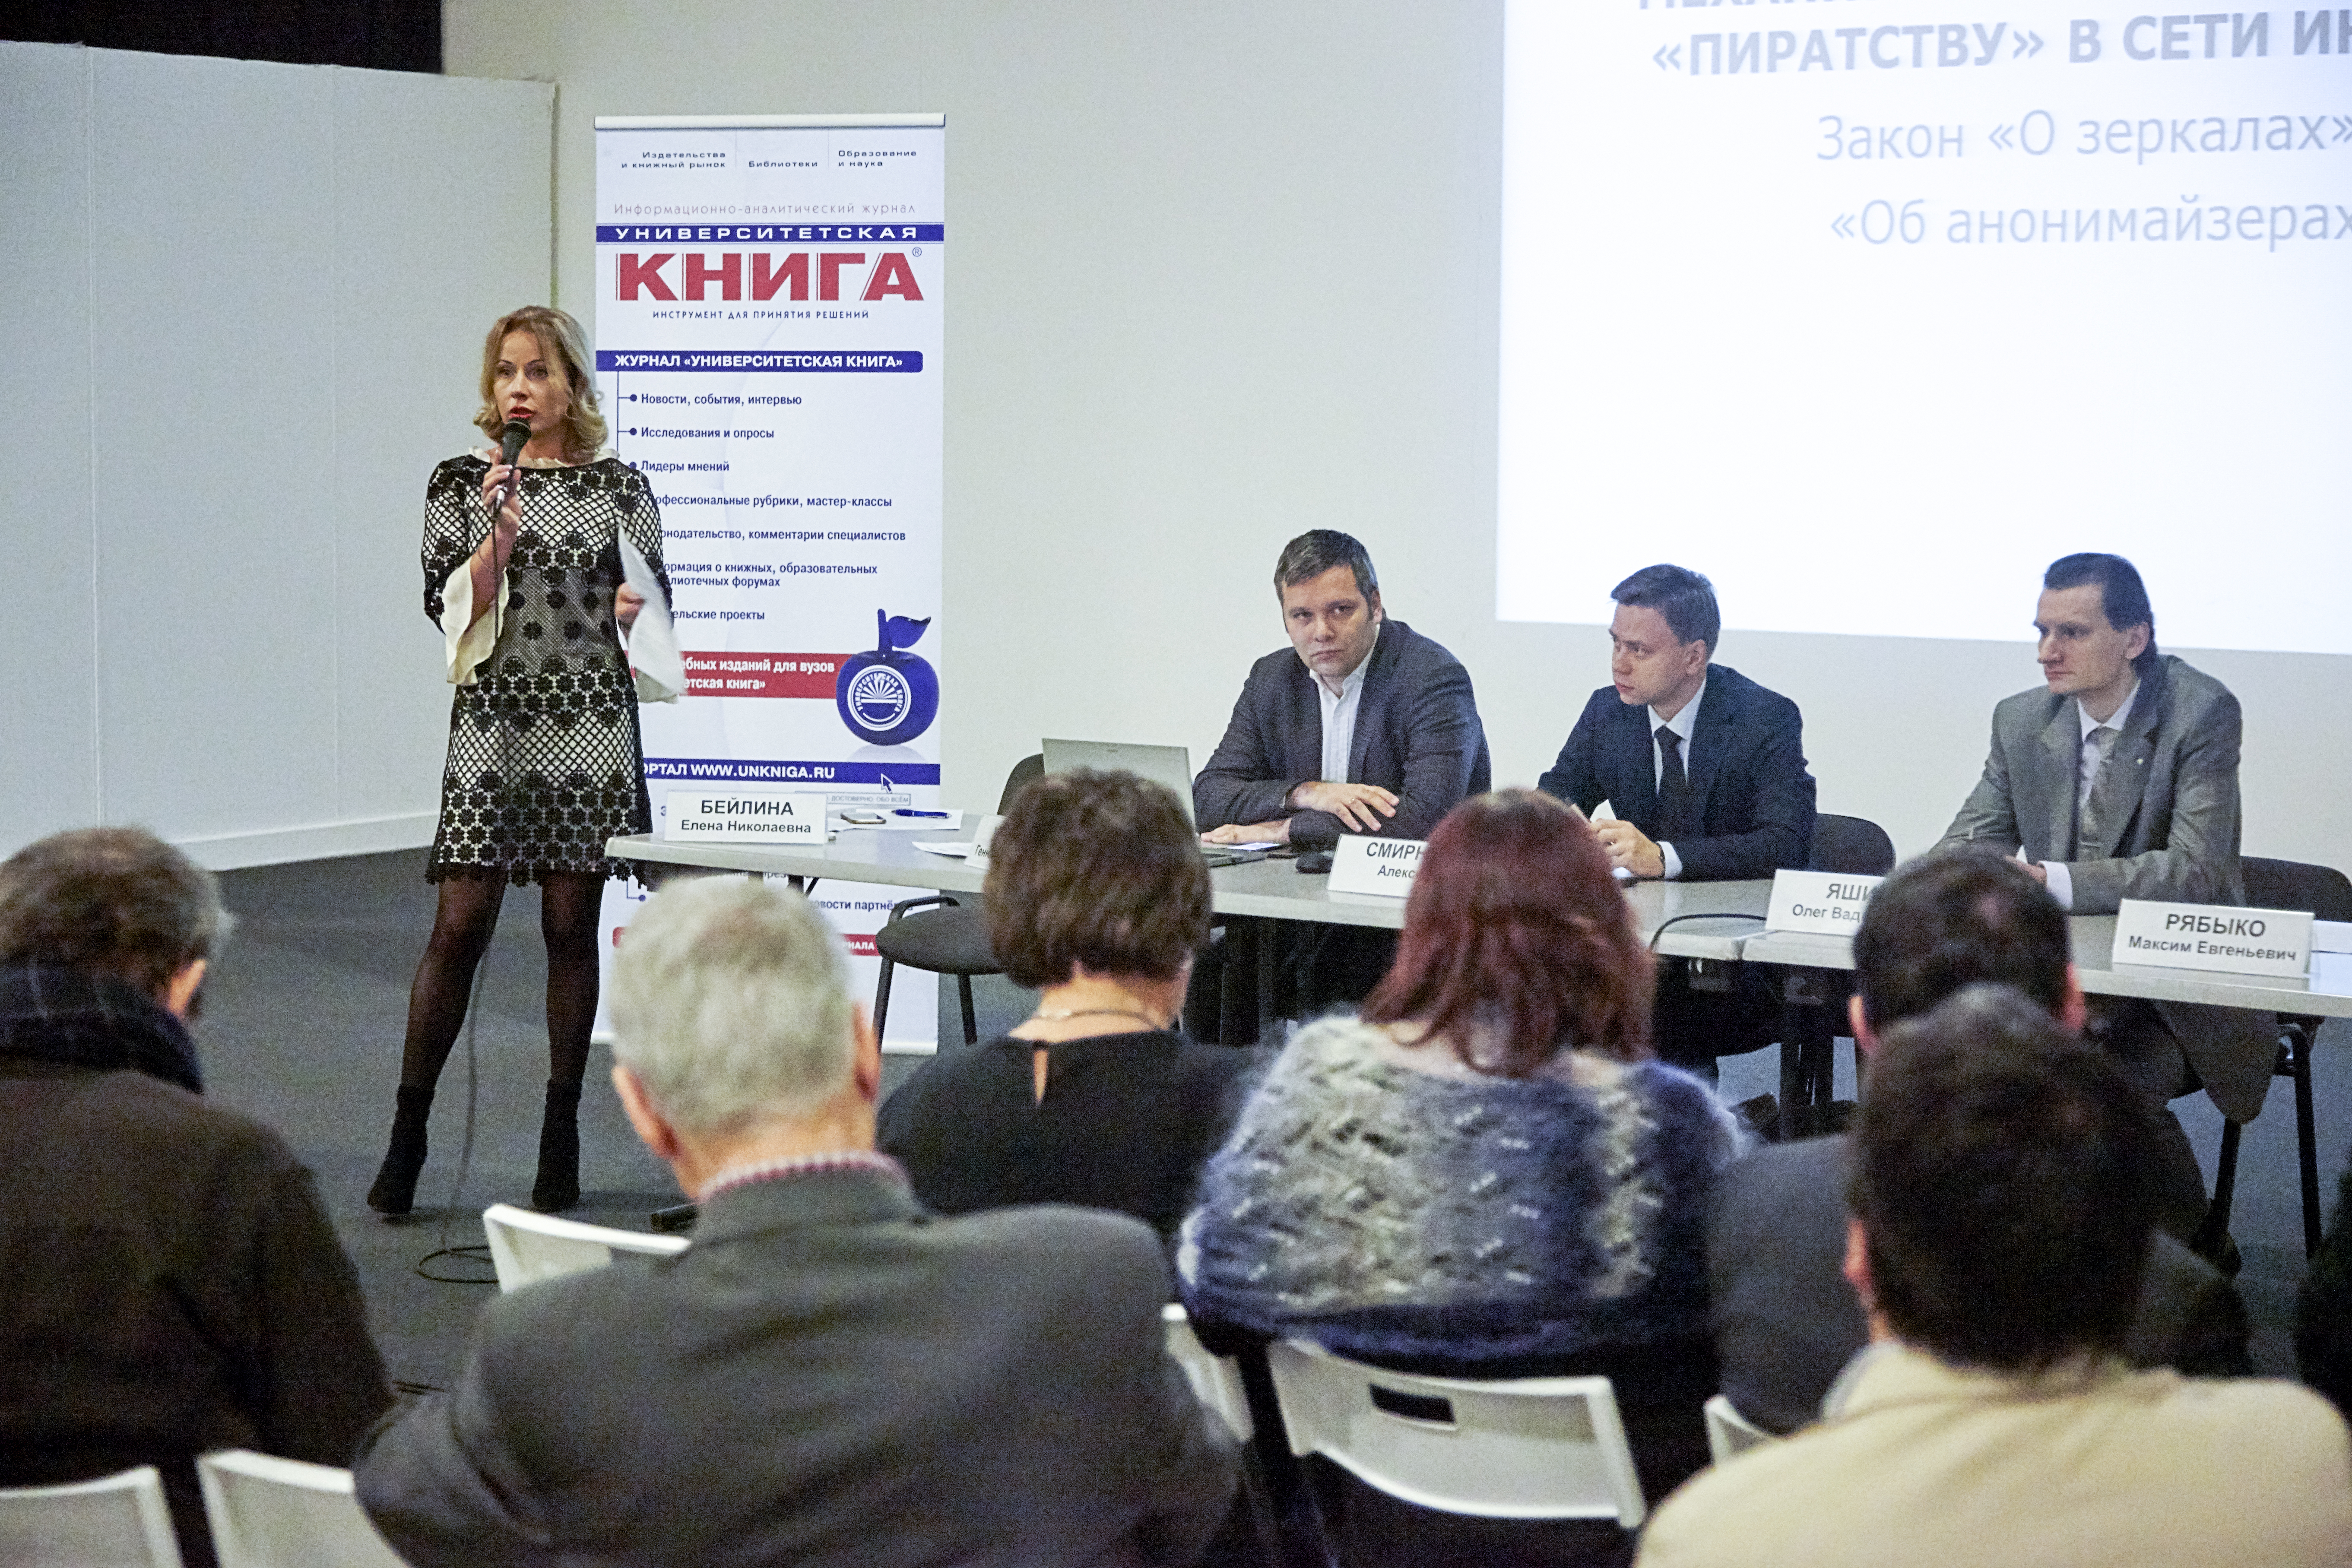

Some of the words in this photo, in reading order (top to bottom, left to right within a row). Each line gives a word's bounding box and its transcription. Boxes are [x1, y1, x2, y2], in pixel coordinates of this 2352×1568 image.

[1652, 22, 2045, 76] «ПИРАТСТВУ»
[2069, 19, 2102, 63] В
[2122, 13, 2269, 61] СЕТИ
[1816, 115, 1964, 160] Закон
[1988, 111, 2055, 155] «О
[614, 203, 854, 216] Информационно-аналитический
[862, 205, 916, 215] журнал
[1831, 199, 1926, 244] «Об
[616, 228, 917, 239] УНИВЕРСИТЕТСКАЯ
[616, 253, 924, 301] КНИГА
[728, 311, 748, 320] ДЛЯ
[754, 311, 811, 319] ПРИНЯТИЯ
[816, 310, 869, 319] РЕШЕНИЙ
[615, 355, 680, 367] ЖУРНАЛ
[685, 355, 843, 367] «УНИВЕРСИТЕТСКАЯ
[846, 356, 903, 367] КНИГА»
[641, 394, 691, 405] Новости,
[694, 394, 744, 406] события,
[748, 395, 802, 406] интервью
[641, 428, 720, 439] Исследования
[733, 429, 774, 440] опросы
[641, 461, 684, 473] Лидеры
[688, 461, 729, 472] мнений
[656, 495, 750, 507] офессиональные
[753, 495, 803, 509] рубрики,
[807, 497, 892, 508] мастер-классы
[660, 529, 745, 542] онодательство,
[749, 531, 824, 541] комментарии
[827, 531, 906, 542] специалистов
[664, 564, 711, 573] ормация
[726, 564, 775, 574] книжных,
[780, 563, 877, 575] образовательных
[732, 576, 780, 589] форумах
[720, 611, 764, 621] проекты
[720, 659, 770, 673] изданий
[773, 661, 797, 672] для
[800, 662, 834, 673] вузов
[726, 679, 765, 689] книга»
[644, 763, 687, 775] РТАЛ
[691, 764, 834, 778] WWW.UNKNIGA.RU
[701, 798, 793, 815] БЕЙЛИНА
[681, 820, 723, 830] Елена
[728, 821, 811, 833] Николаевна
[1377, 865, 1415, 878] Алекс
[815, 901, 851, 909] вости
[1793, 904, 1827, 917] Олег
[1832, 907, 1860, 922] Вад
[2166, 913, 2265, 937] РЯБЫКО
[2129, 935, 2191, 953] Максим
[2198, 941, 2296, 961] Евгеньевич
